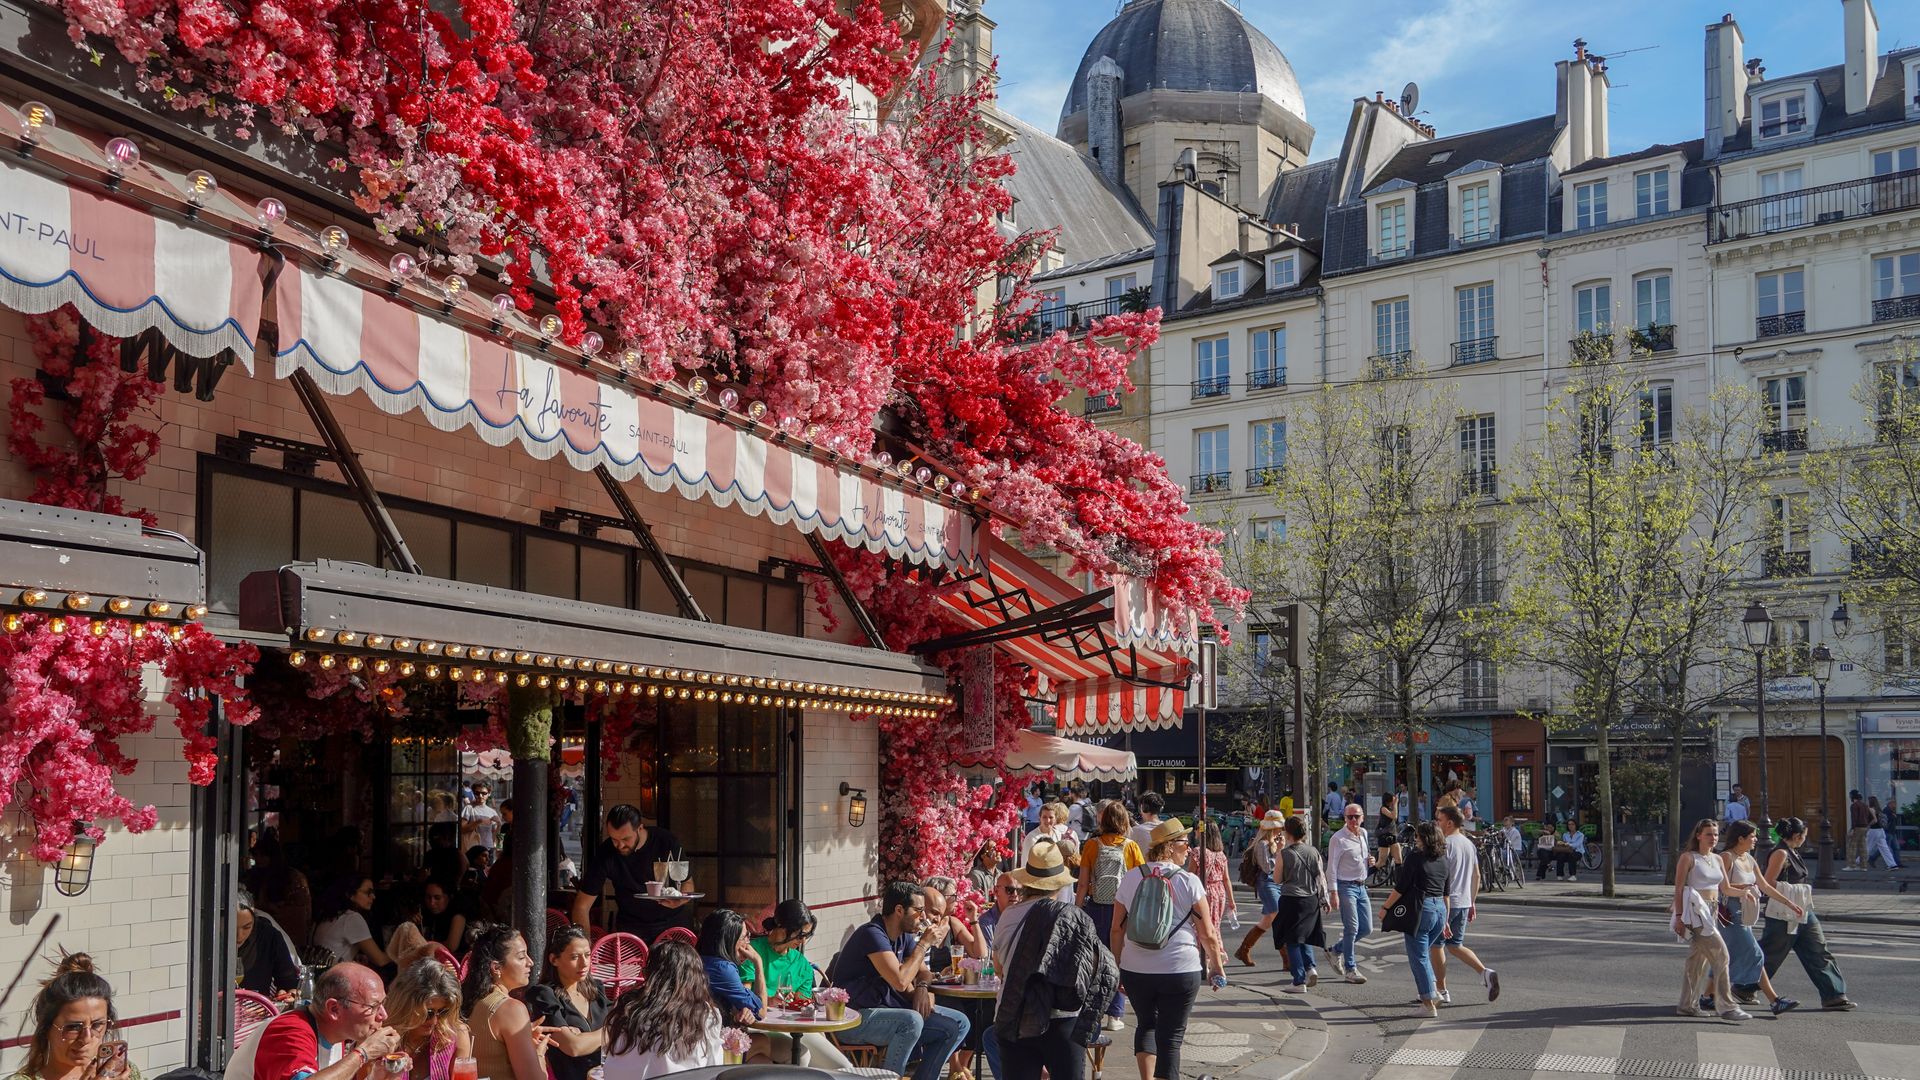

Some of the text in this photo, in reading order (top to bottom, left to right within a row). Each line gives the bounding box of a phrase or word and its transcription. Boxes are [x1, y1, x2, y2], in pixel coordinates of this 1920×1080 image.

[497, 352, 612, 439] La favorite
[629, 424, 689, 455] SAINT-PAUL
[1147, 759, 1186, 767] PIZZA MOMO
